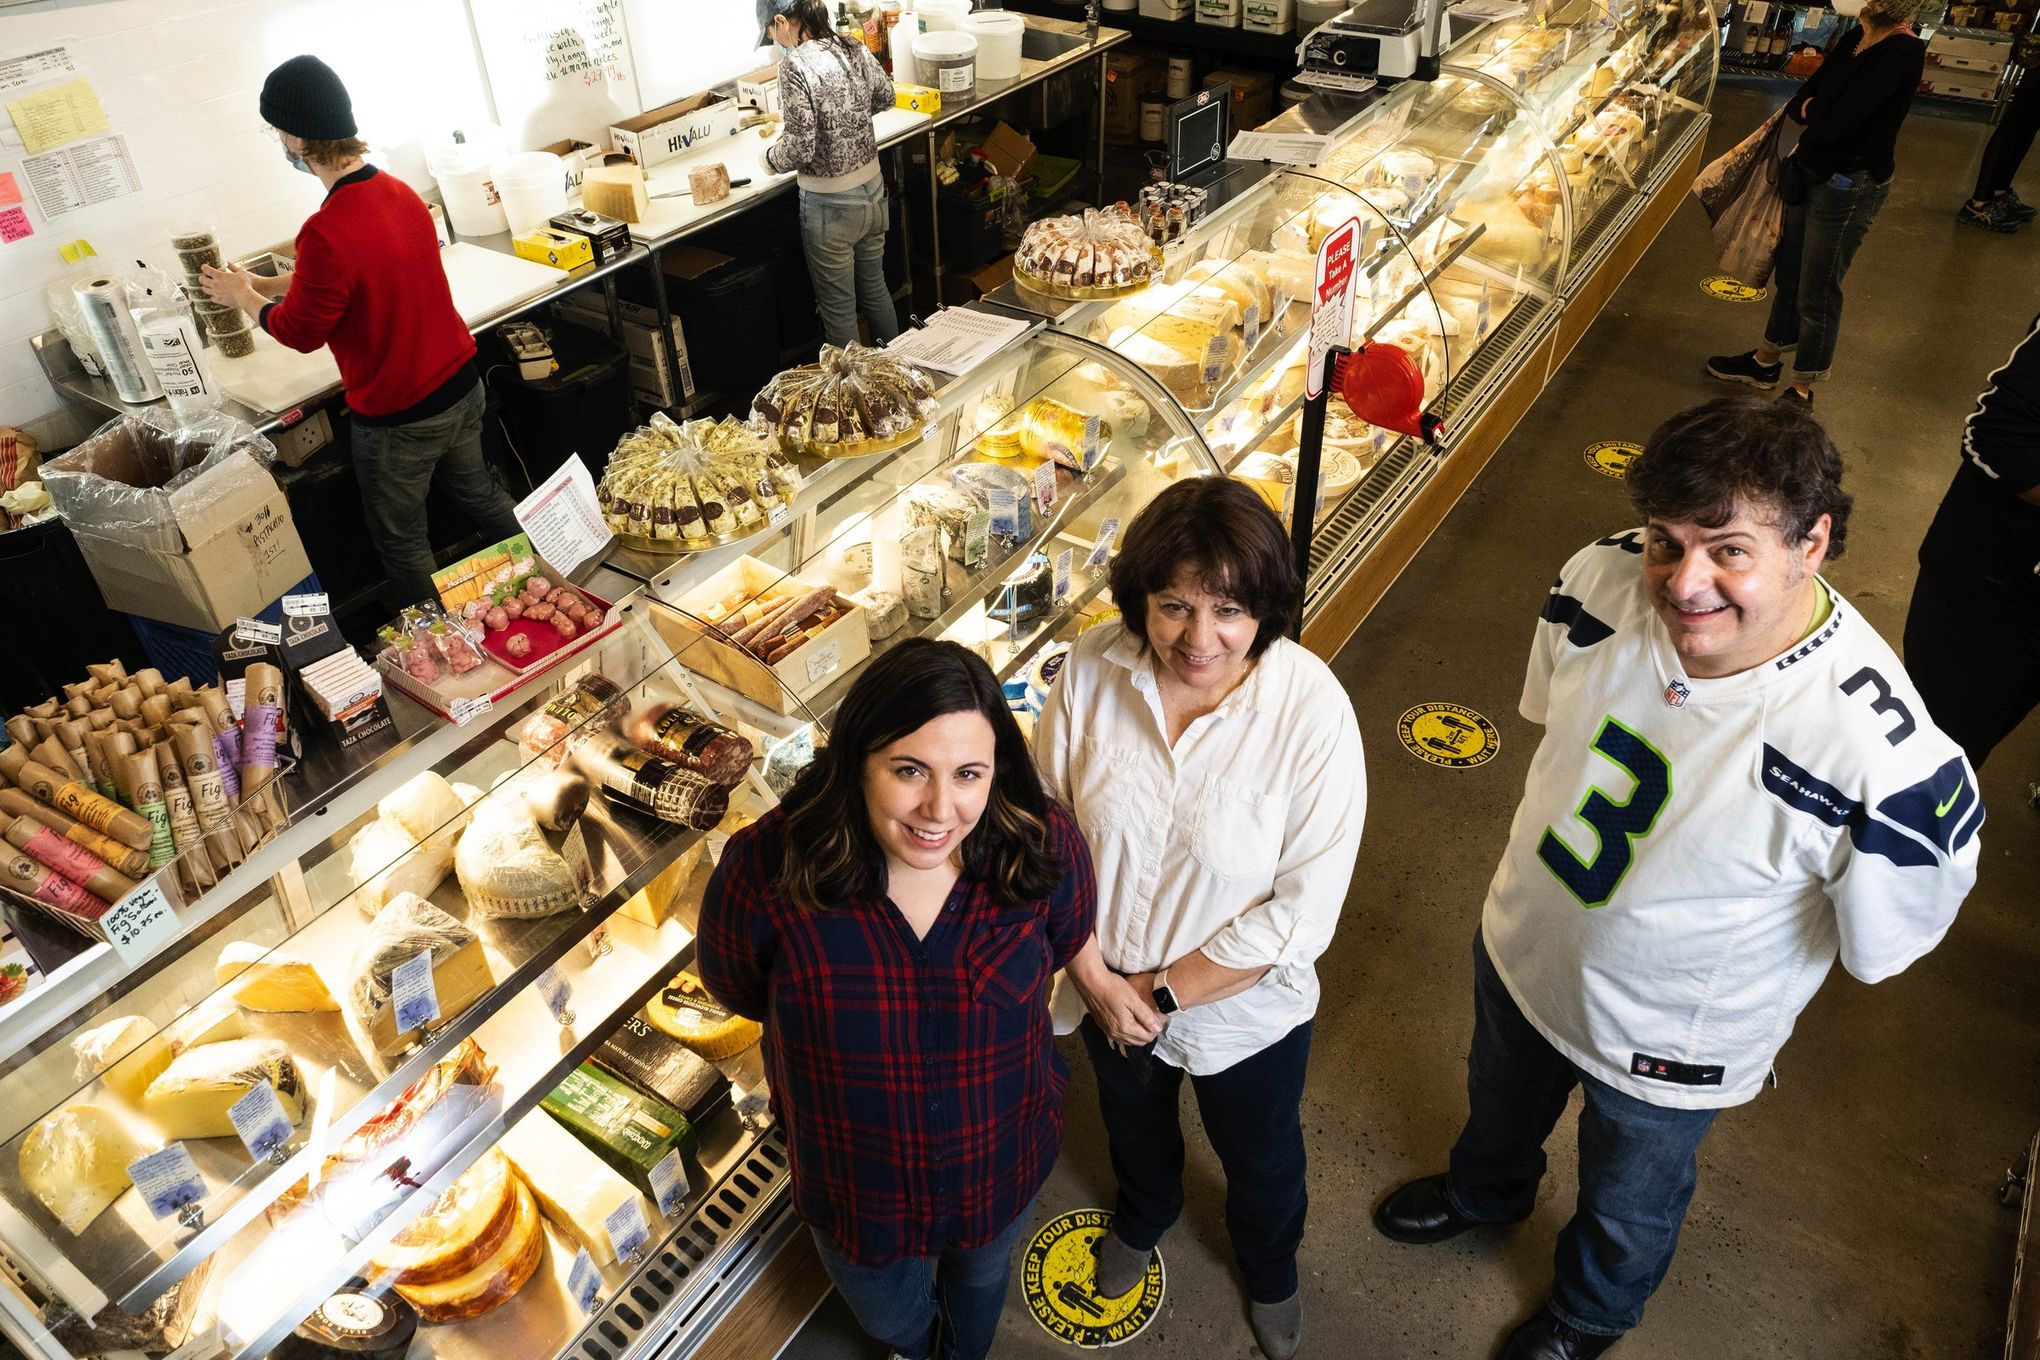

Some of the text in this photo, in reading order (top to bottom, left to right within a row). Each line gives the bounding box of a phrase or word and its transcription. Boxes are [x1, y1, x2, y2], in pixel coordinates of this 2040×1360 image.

[668, 124, 712, 153] HIVALU
[1328, 240, 1351, 265] PLEASE
[1329, 263, 1348, 281] Take A
[1325, 275, 1349, 299] Number
[181, 367, 194, 376] 50
[253, 514, 285, 547] PISTACHIO
[287, 624, 328, 646] TAZA CHOCOLATE
[225, 647, 267, 660] TAZA CHOCOLATE
[1666, 687, 1682, 706] NFL
[1839, 666, 1917, 747] 3
[341, 716, 393, 748] TAZA CHOCOLATE
[1401, 704, 1481, 766] PLEASE KEEP YOUR DISTANCE
[1466, 727, 1497, 765] WAIT HERE
[60, 791, 80, 809] Fig
[201, 782, 222, 800] Fig
[174, 798, 194, 815] Fig
[1536, 714, 1673, 908] 3
[147, 810, 167, 829] Fig
[47, 877, 72, 898] Fig
[106, 904, 130, 927] 100%
[110, 919, 132, 936] Fig
[610, 1041, 628, 1058] MATURE
[1027, 1213, 1112, 1341] PLEASE KEEP YOUR DIST
[1108, 1263, 1161, 1340] WAIT HERE
